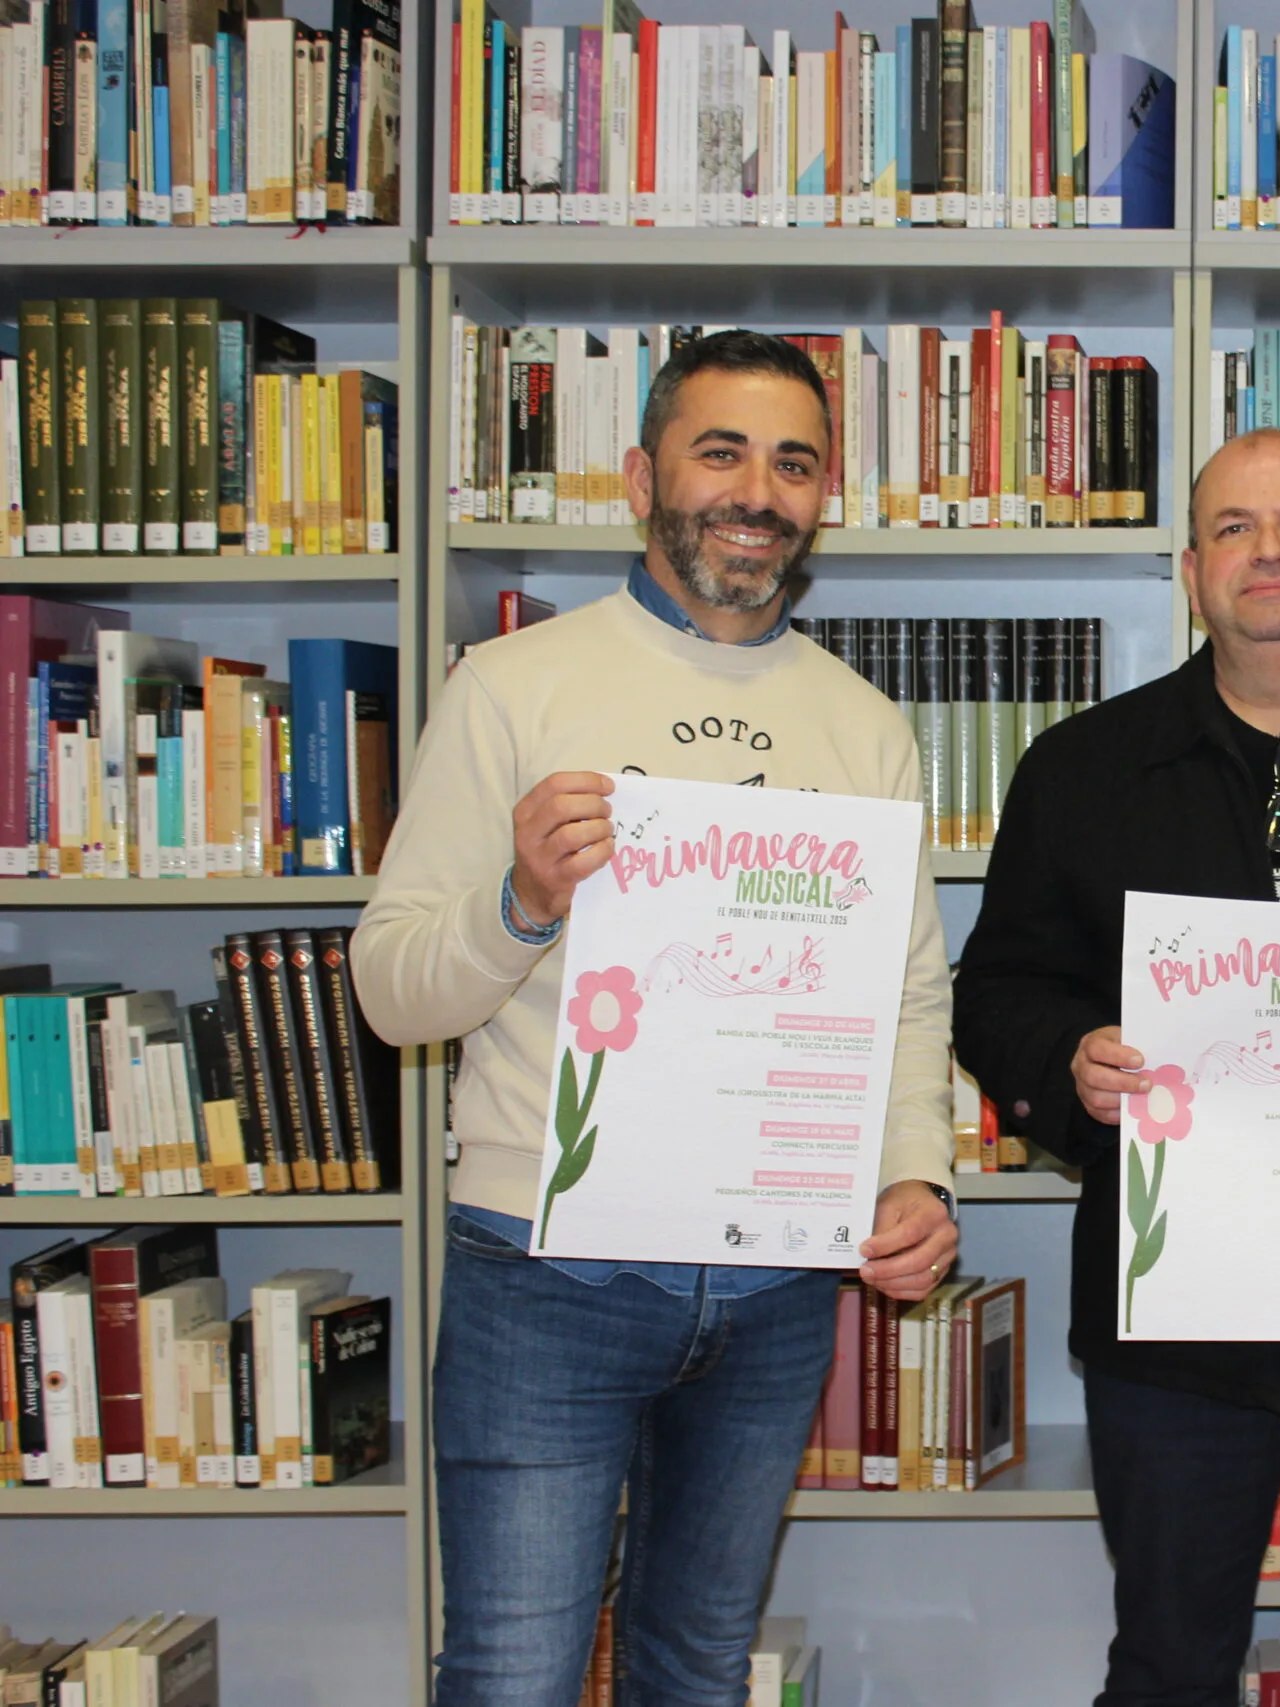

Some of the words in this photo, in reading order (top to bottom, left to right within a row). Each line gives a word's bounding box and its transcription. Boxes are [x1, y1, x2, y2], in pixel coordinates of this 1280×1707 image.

[339, 27, 349, 49] mar
[530, 40, 546, 54] D
[338, 50, 350, 70] que
[526, 57, 546, 85] DÍA
[52, 47, 65, 127] CAMBRILS
[335, 72, 348, 94] más
[530, 87, 546, 113] EL
[335, 95, 347, 129] Blanca
[333, 130, 346, 159] Costa
[511, 364, 520, 401] ESPAÑOL
[519, 364, 528, 375] EL
[541, 363, 552, 393] PAUL
[519, 375, 529, 431] HOLOCAUSTO
[529, 363, 541, 416] PRESTON
[1049, 399, 1060, 444] contra
[1058, 415, 1072, 480] Napoleón
[1048, 447, 1061, 496] España
[672, 716, 772, 751] OOTO
[608, 824, 863, 894] primavera
[736, 870, 834, 908] MUSICAL
[718, 907, 725, 917] EL
[728, 908, 750, 918] POBLE
[754, 910, 767, 919] NOU
[770, 911, 778, 920] DE
[781, 911, 827, 924] BENITATXELL
[830, 915, 847, 925] 2025
[238, 974, 259, 1049] HUMANIDAD
[299, 974, 320, 1049] HUMANIDAD
[1255, 1009, 1262, 1017] EL
[256, 1072, 272, 1130] HISTORIA
[315, 1072, 332, 1130] HISTORIA
[20, 1318, 37, 1364] Egipto
[24, 1365, 41, 1417] Antiguo
